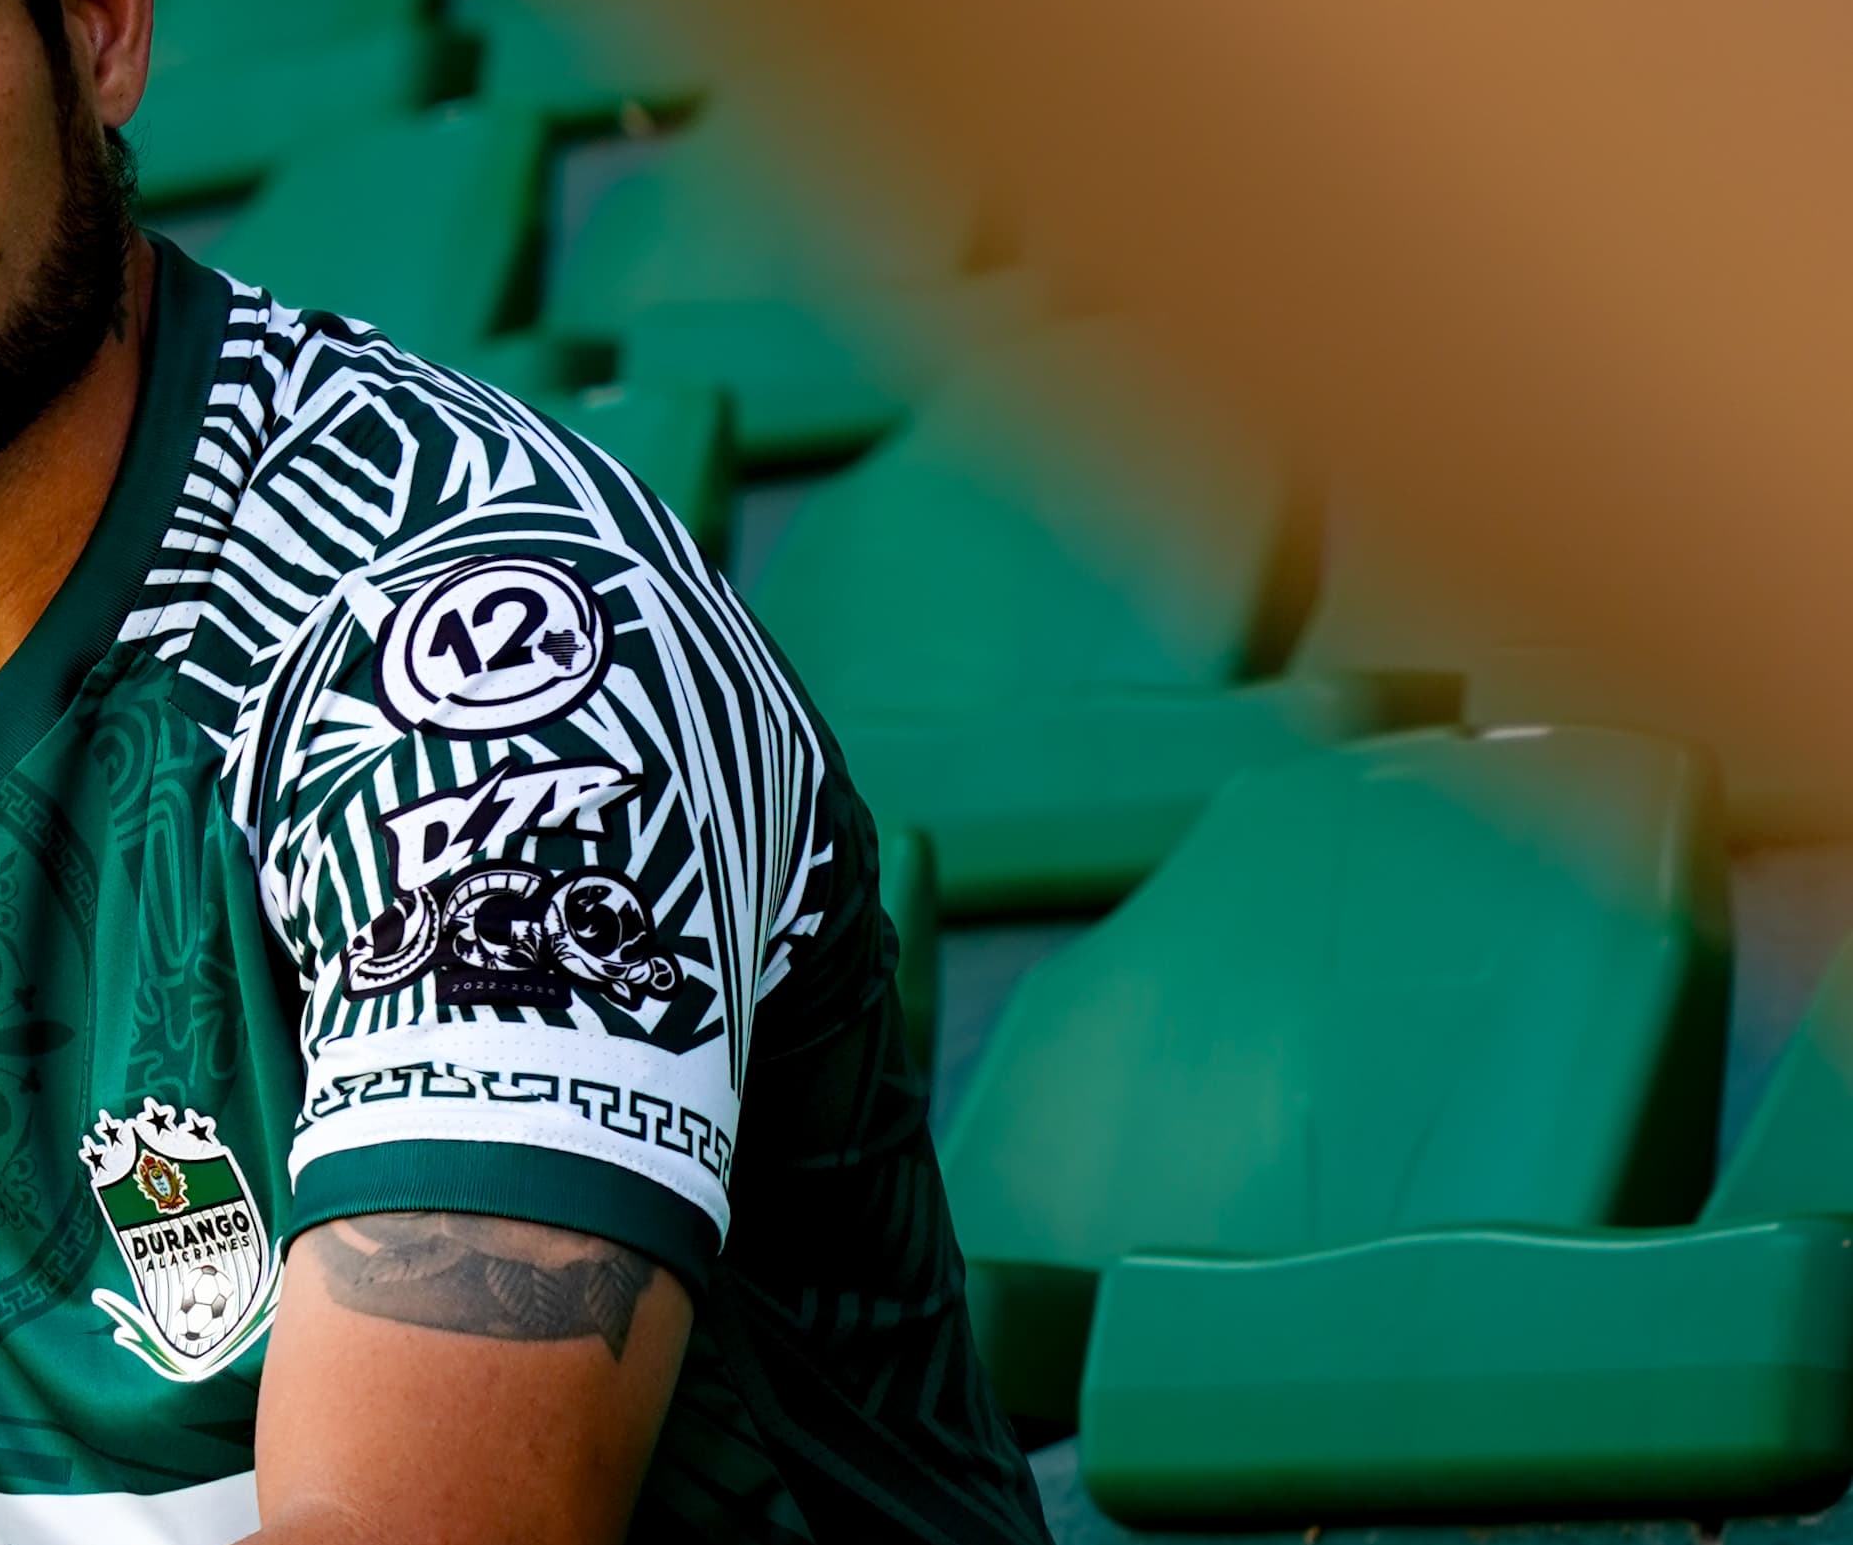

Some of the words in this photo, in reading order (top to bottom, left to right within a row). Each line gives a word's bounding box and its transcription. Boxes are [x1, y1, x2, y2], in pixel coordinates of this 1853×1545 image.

[427, 586, 549, 680] 12
[131, 1210, 250, 1260] DURANGO
[145, 1235, 250, 1273] ALACRANES
